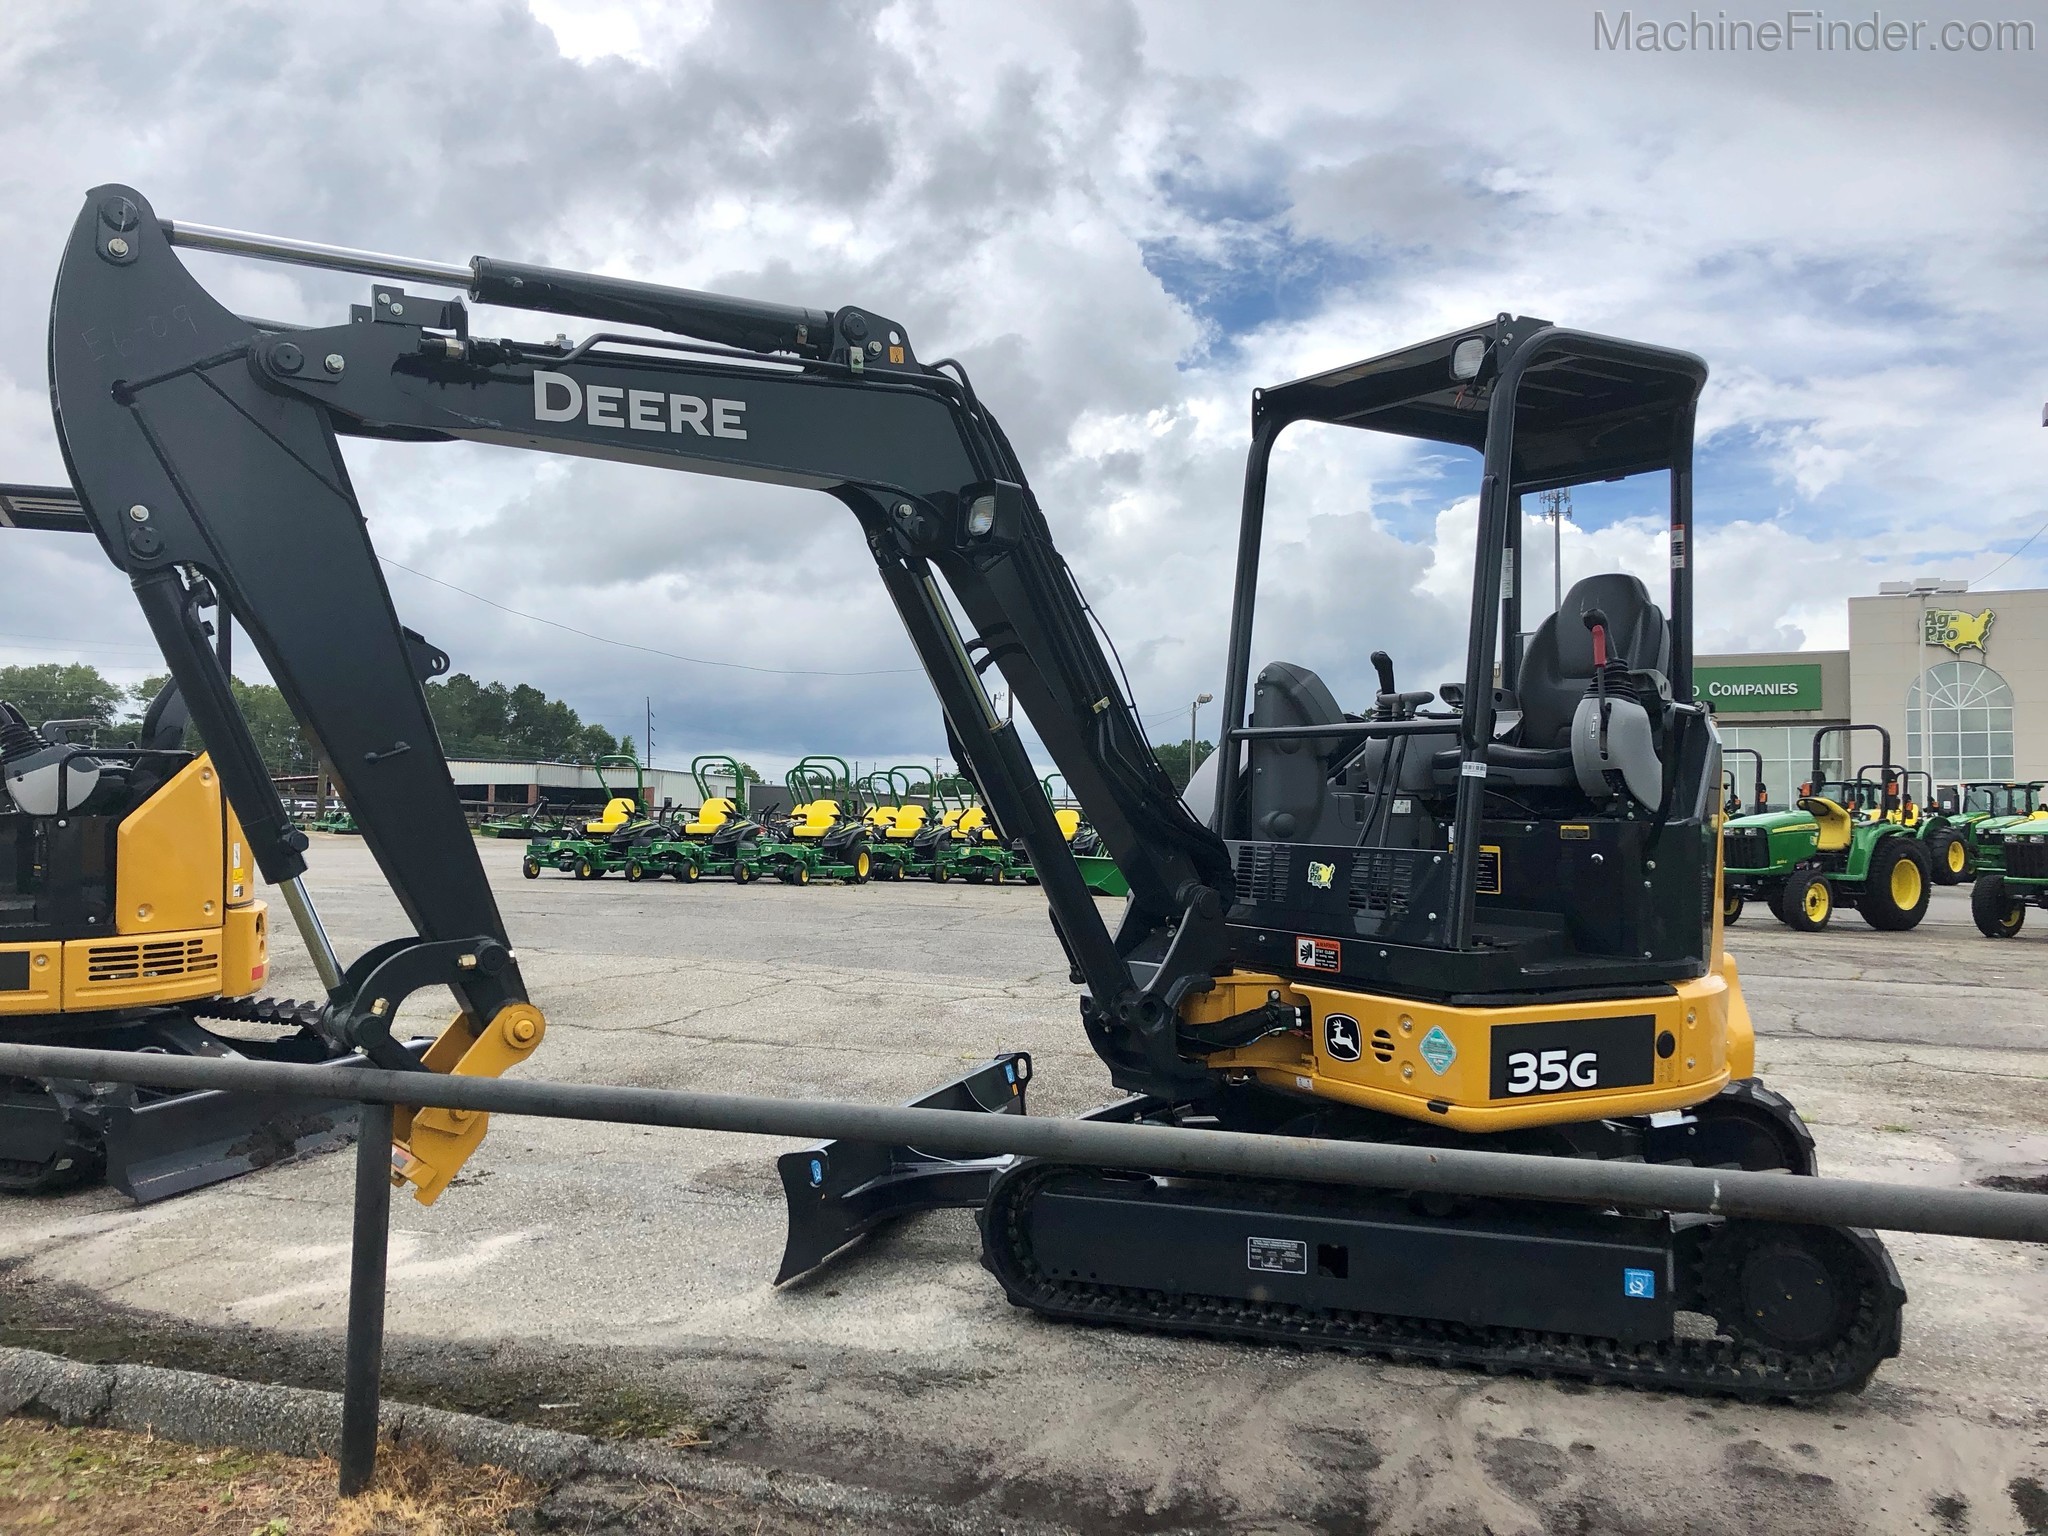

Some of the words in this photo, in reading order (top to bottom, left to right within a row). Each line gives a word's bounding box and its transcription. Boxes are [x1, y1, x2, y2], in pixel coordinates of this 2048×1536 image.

[533, 370, 748, 440] DEERE
[1925, 626, 1958, 641] Pro
[1708, 681, 1798, 696] COMPANIES
[1508, 1050, 1598, 1094] 35G
